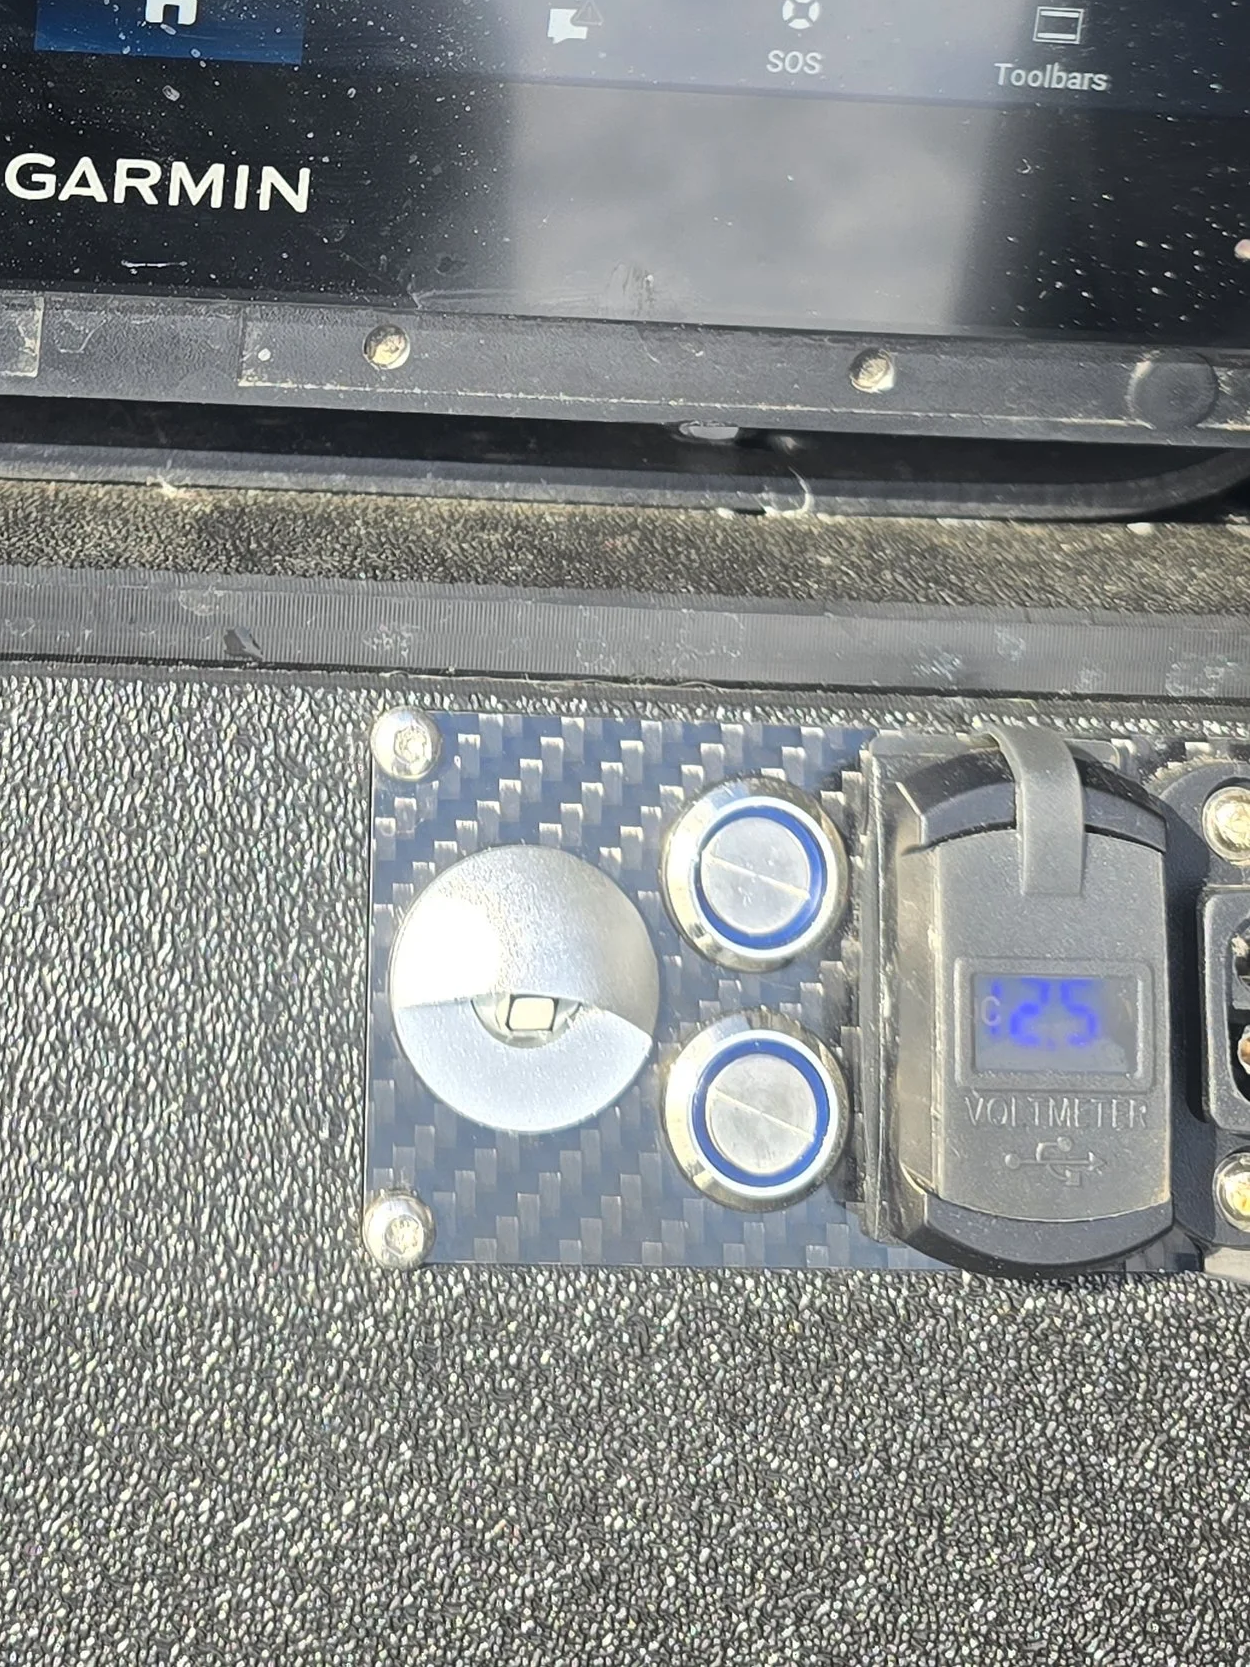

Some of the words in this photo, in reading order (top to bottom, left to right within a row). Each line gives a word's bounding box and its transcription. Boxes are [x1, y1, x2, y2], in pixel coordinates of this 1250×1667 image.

[766, 49, 823, 75] SOS
[993, 61, 1110, 92] Toolbars
[3, 152, 312, 214] GARMIN
[964, 1095, 1147, 1129] VOLTMETER
